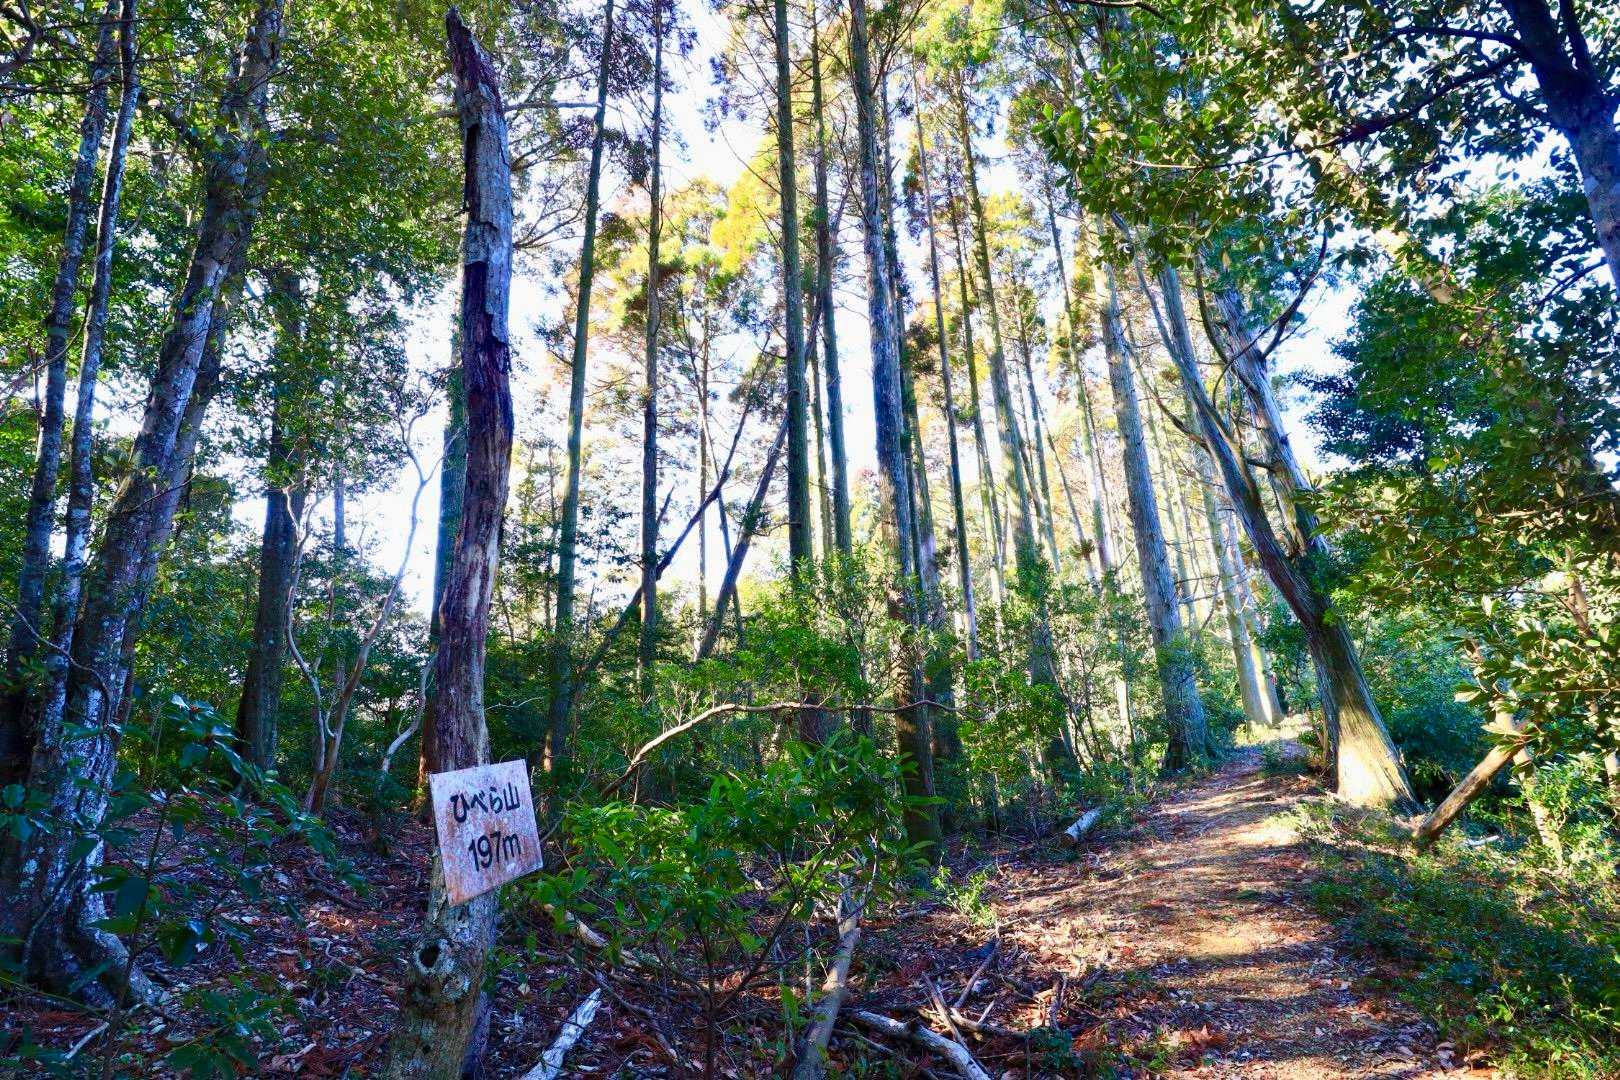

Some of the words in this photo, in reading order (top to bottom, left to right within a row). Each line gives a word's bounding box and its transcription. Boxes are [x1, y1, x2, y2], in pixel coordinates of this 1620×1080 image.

[450, 782, 520, 823] ひべら山
[468, 831, 522, 872] 197m
